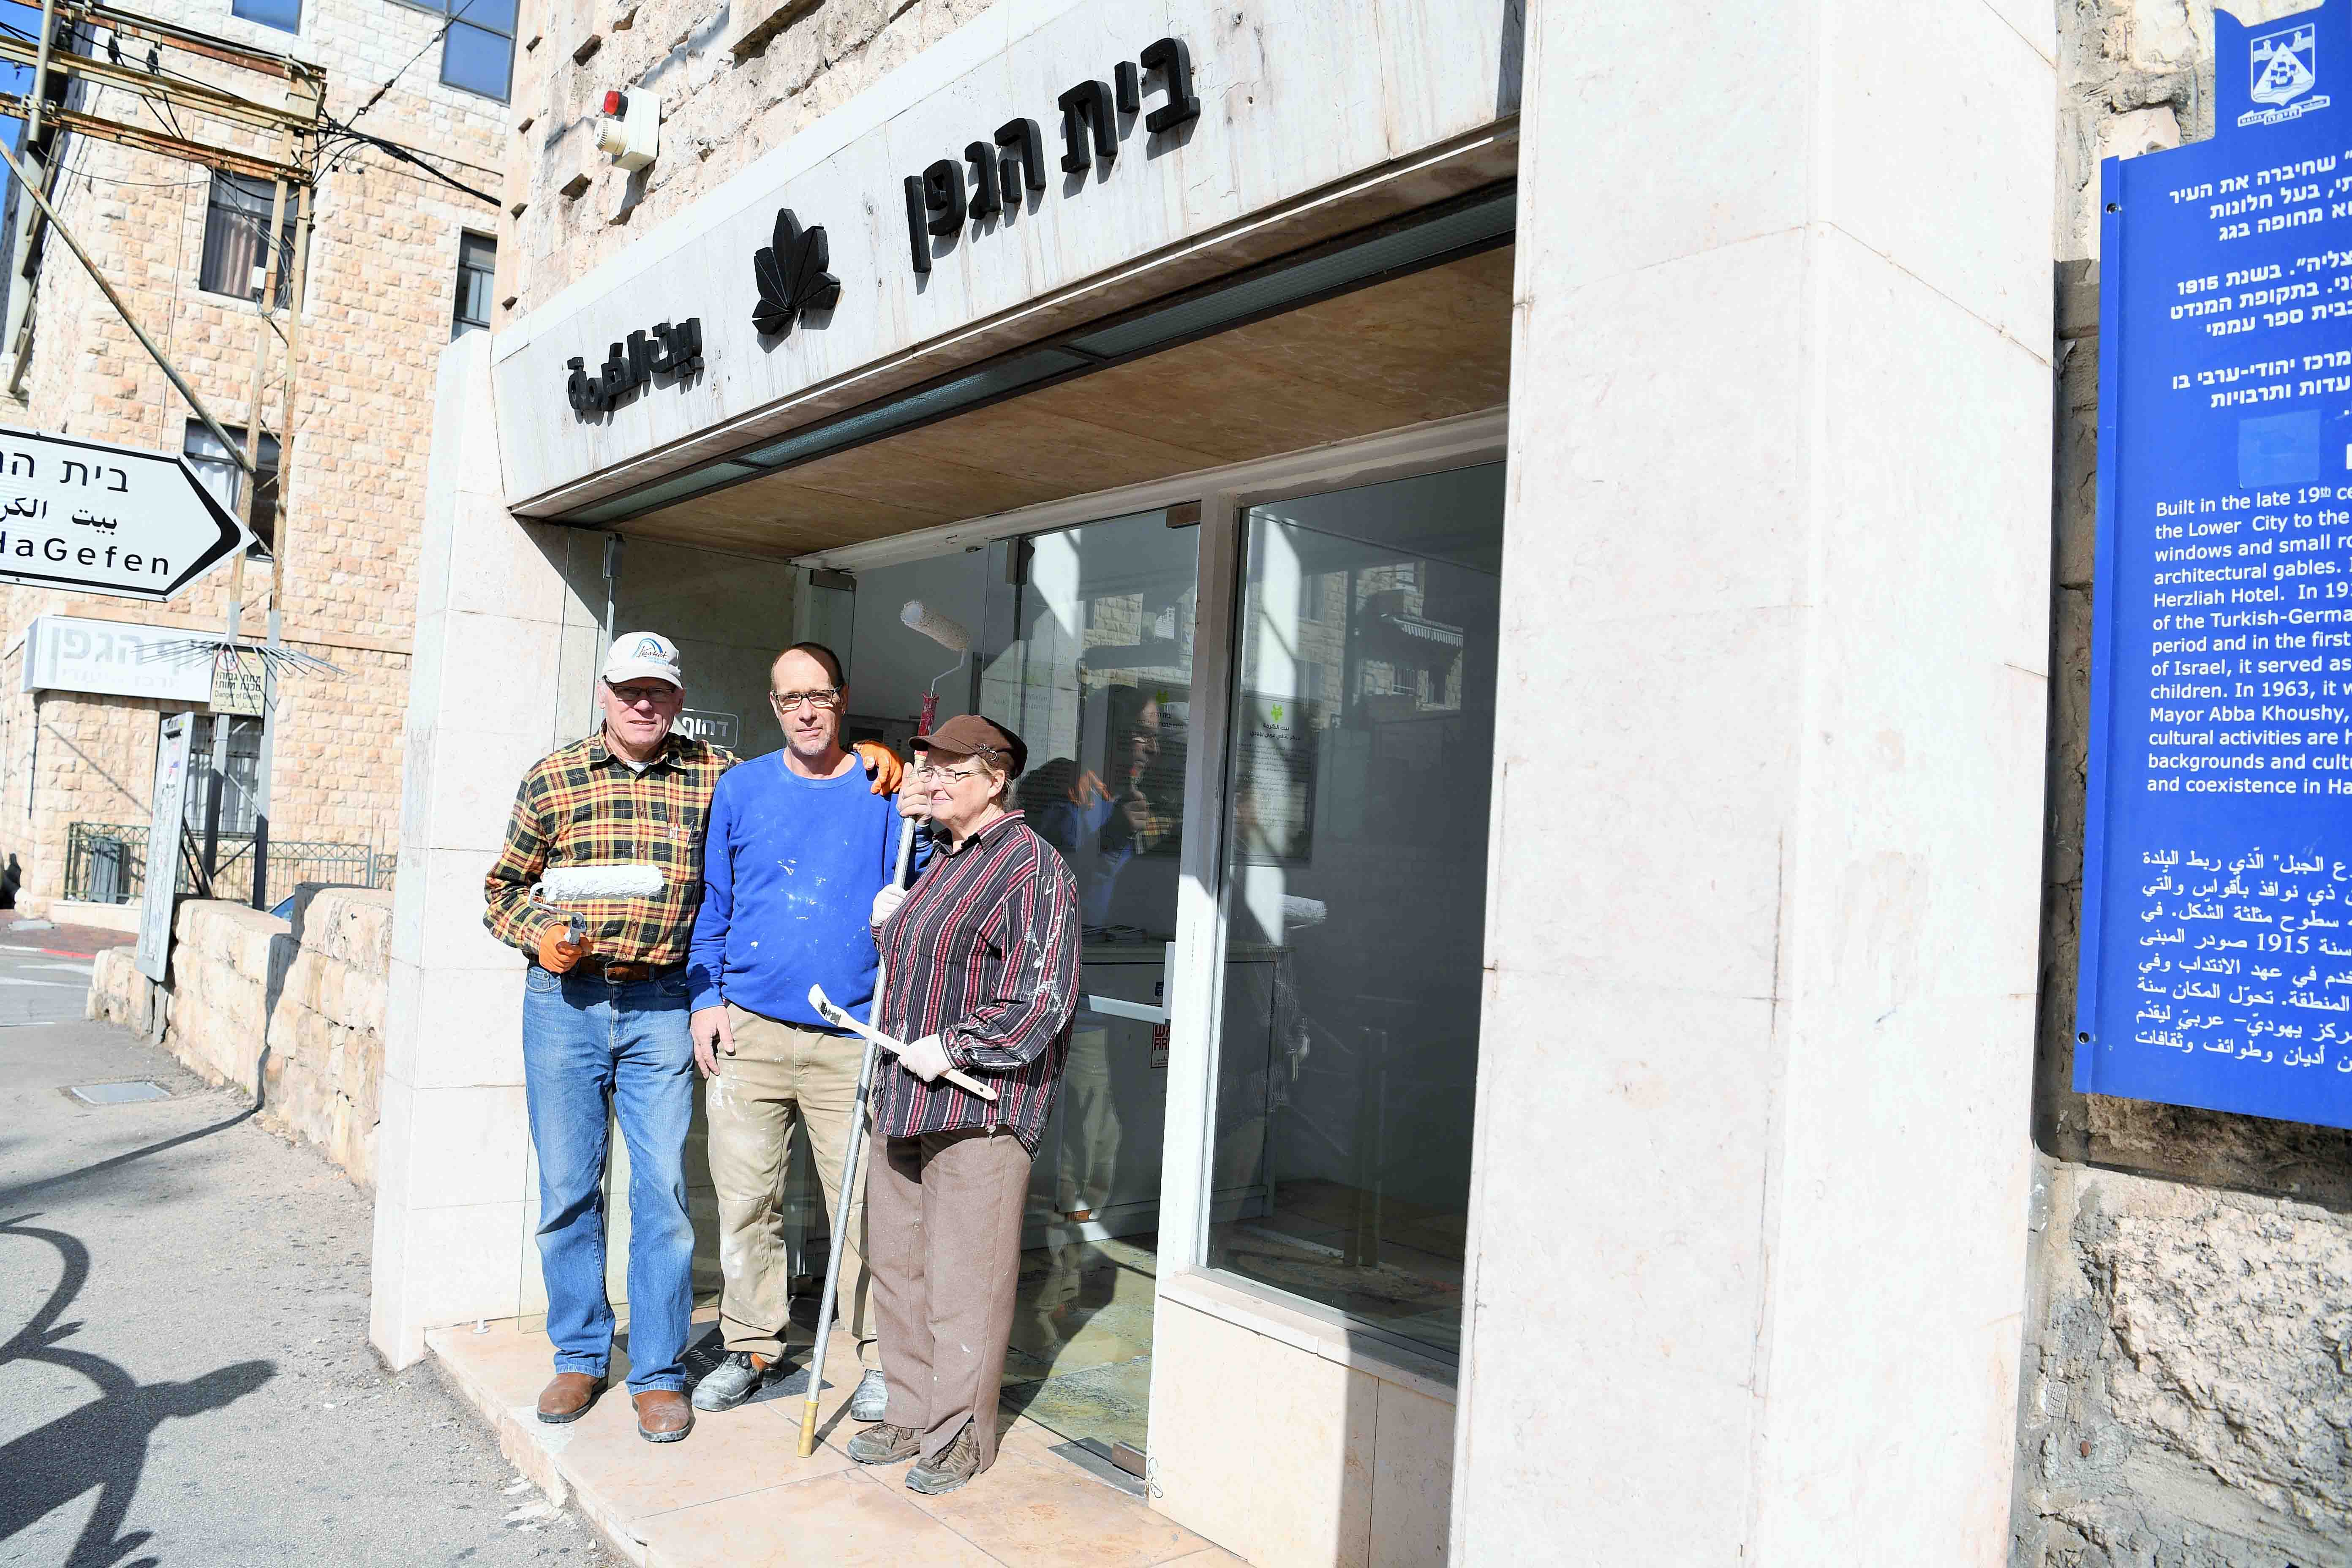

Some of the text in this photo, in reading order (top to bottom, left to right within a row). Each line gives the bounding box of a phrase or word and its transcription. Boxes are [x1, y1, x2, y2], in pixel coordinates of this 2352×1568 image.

[904, 37, 1201, 273] בית הגפן
[2169, 155, 2336, 204] שחיברה את העיר
[2281, 184, 2320, 204] בעל
[2210, 194, 2273, 219] חלונות
[2257, 208, 2322, 233] מחופה
[2219, 223, 2250, 241] בגג
[2177, 275, 2219, 295] 1915
[2226, 264, 2282, 287] בשנת
[2239, 282, 2319, 308] בתקופת
[2170, 297, 2232, 319] המנדט
[2263, 309, 2303, 327] ספר
[2206, 316, 2255, 336] עממי
[648, 318, 704, 378] بيت
[2172, 375, 2190, 389] בו
[2197, 359, 2295, 385] יהודי-ערבי
[2211, 376, 2350, 408] עדות ותרבויות
[60, 460, 128, 493] בית
[2156, 499, 2195, 517] Built
[2200, 498, 2216, 512] in
[2221, 495, 2251, 511] the
[2257, 491, 2290, 507] late
[71, 509, 117, 536] بيت
[2155, 509, 2349, 539] the Lower City to the
[2155, 544, 2232, 562] windows
[2238, 538, 2272, 556] and
[2279, 534, 2330, 553] small
[2154, 562, 2267, 585] architectural
[2273, 559, 2341, 581] gables.
[2154, 581, 2352, 607] Herzliah Hotel. In 19
[2153, 615, 2171, 631] of
[2175, 614, 2205, 629] the
[48, 626, 144, 683] הגפן
[2153, 631, 2351, 656] period and in the first
[2151, 655, 2351, 677] of Israel, it served as
[2151, 683, 2227, 699] children.
[2235, 682, 2254, 697] In
[2262, 681, 2315, 699] 1963,
[2323, 680, 2336, 696] it
[2151, 704, 2349, 725] Mayor Abba Khoushy,
[682, 717, 729, 740] דחוף
[2149, 730, 2213, 745] cultural
[2219, 730, 2301, 745] activities
[2307, 732, 2338, 745] are
[2149, 753, 2352, 772] backgrounds and cult
[2147, 776, 2179, 792] and
[2186, 777, 2297, 794] coexistence
[2304, 778, 2320, 794] in
[2143, 849, 2179, 868] البلدة
[2186, 850, 2221, 872] ربط
[2258, 880, 2298, 902] نوافذ
[2307, 884, 2335, 906] ذي
[2141, 901, 2163, 922] في
[2233, 905, 2273, 923] مثلثة
[2280, 909, 2339, 933] سطوح
[2140, 928, 2185, 946] المبنى
[2193, 935, 2248, 951] صودر
[2257, 933, 2309, 954] 1915
[2139, 953, 2171, 973] وفي
[2179, 956, 2240, 975] الانتداب
[2251, 965, 2282, 981] عهد
[2137, 976, 2167, 994] سنة
[2292, 965, 2317, 988] في
[2172, 980, 2220, 999] المكان
[2311, 1022, 2352, 1045] ركز
[2203, 1038, 2273, 1063] وطوائف
[2284, 1045, 2325, 1067] أديان
